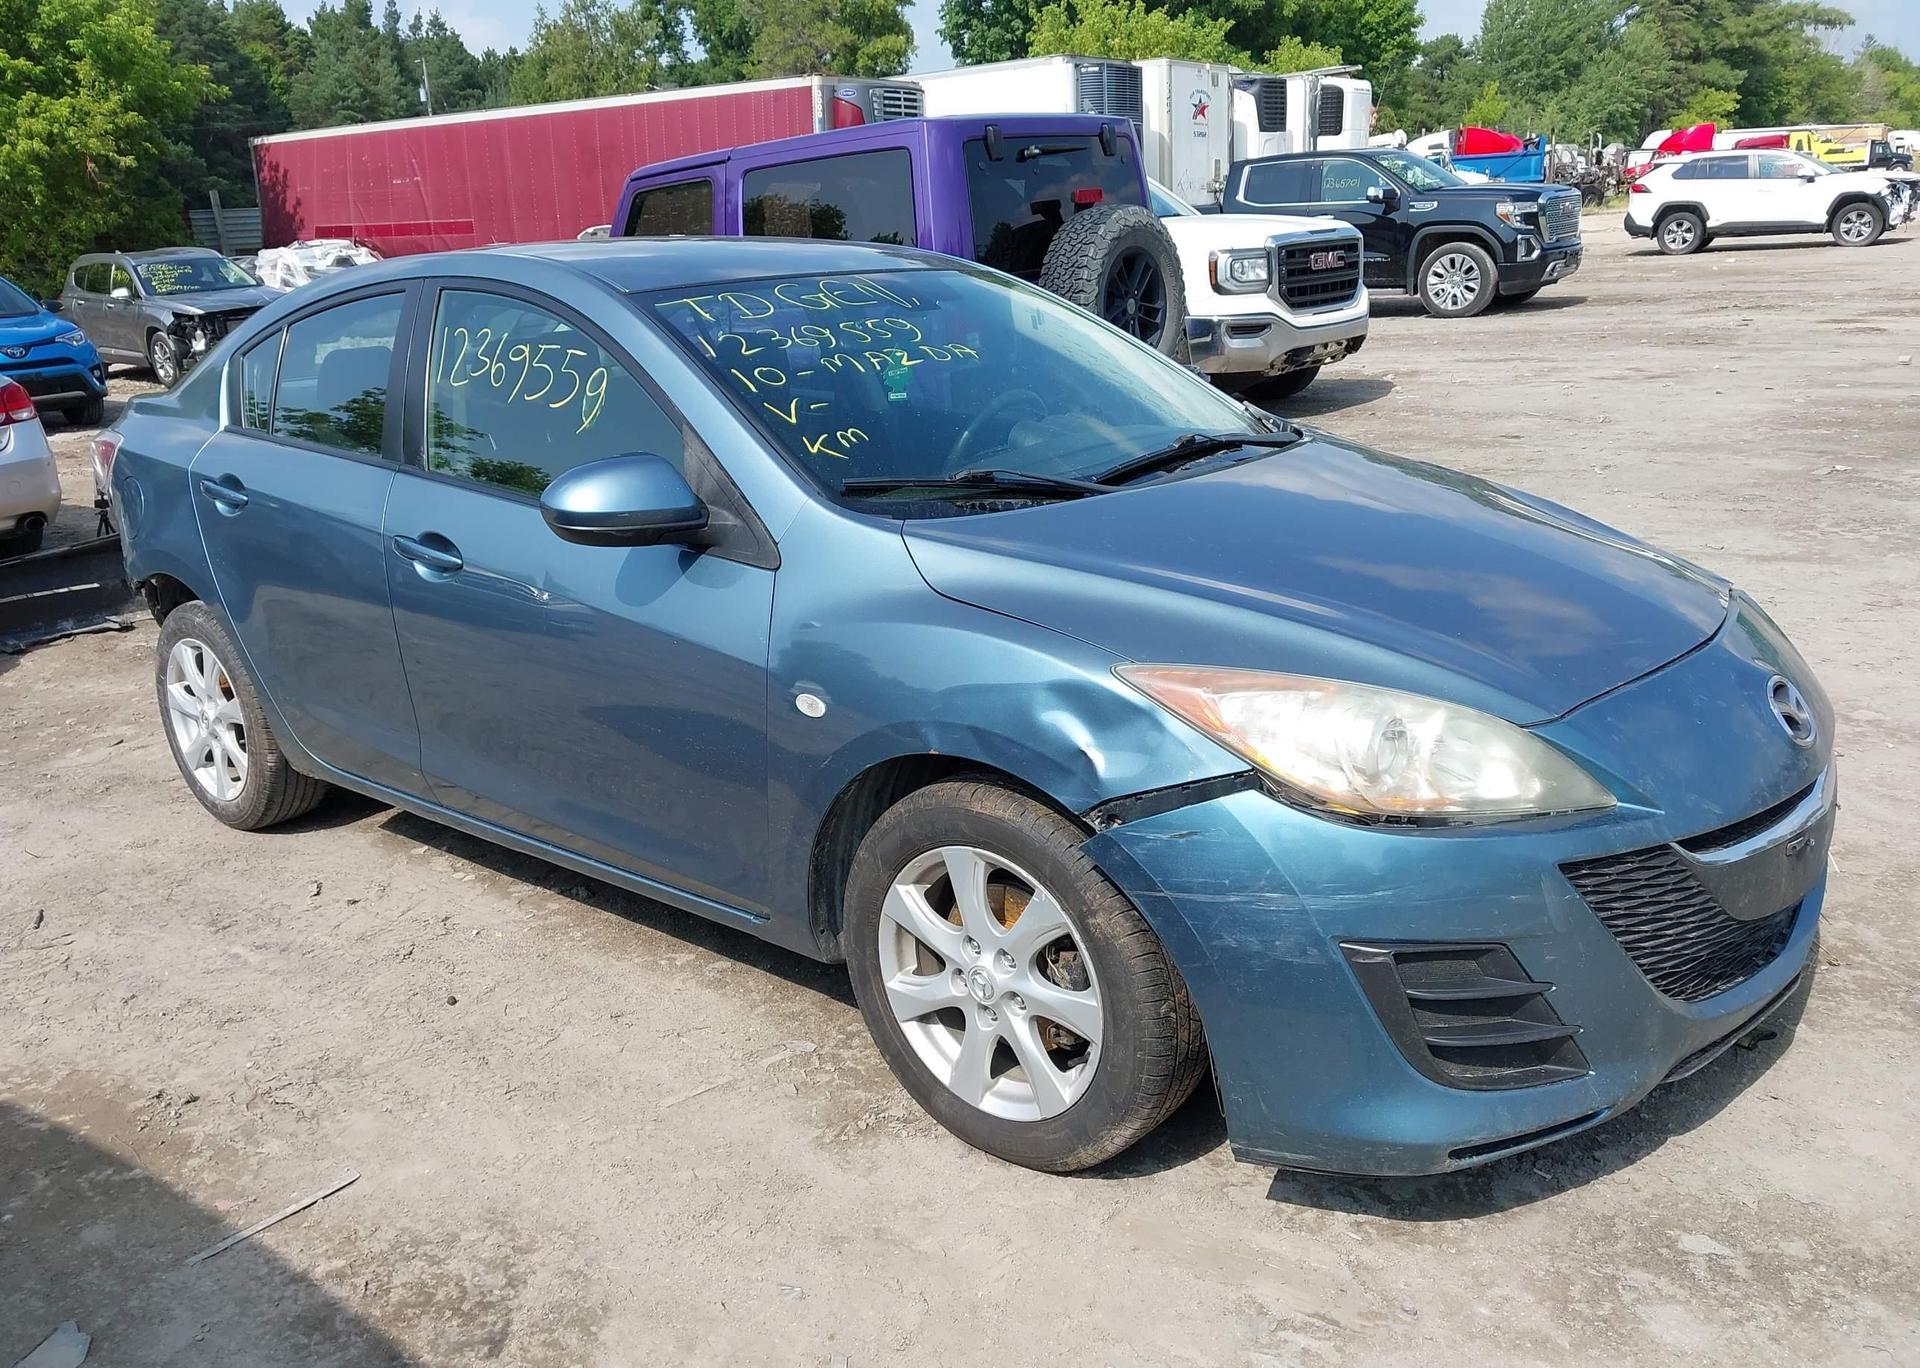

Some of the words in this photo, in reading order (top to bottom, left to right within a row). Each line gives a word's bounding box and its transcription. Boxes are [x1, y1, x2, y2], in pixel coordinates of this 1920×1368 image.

[1310, 250, 1346, 270] GMC
[697, 317, 922, 357] 12369559
[437, 327, 608, 434] 12369559
